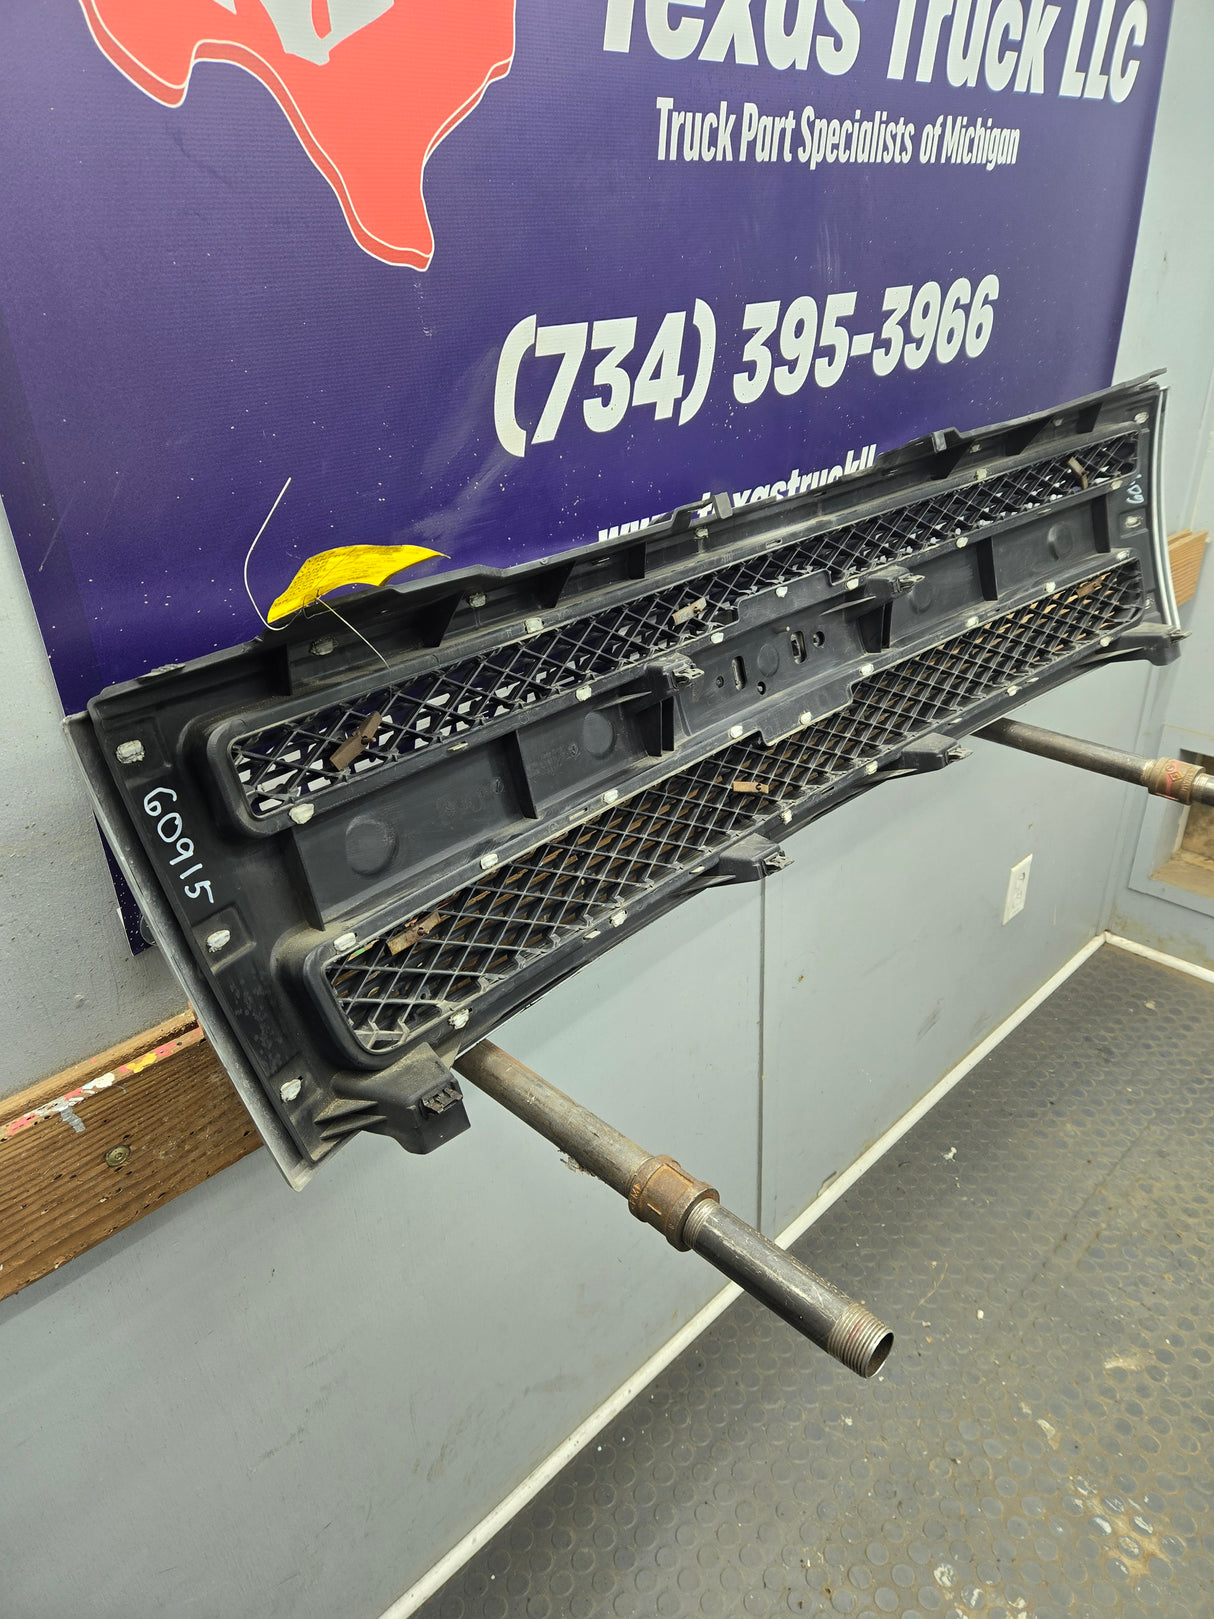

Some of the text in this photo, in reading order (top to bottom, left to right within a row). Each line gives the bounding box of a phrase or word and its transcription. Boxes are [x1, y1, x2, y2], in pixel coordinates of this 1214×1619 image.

[603, 0, 861, 76] exas
[655, 96, 1021, 172] Truck Part Specialists of Michigan
[493, 273, 1001, 458] (734) 395-3966
[143, 786, 215, 904] 60915
